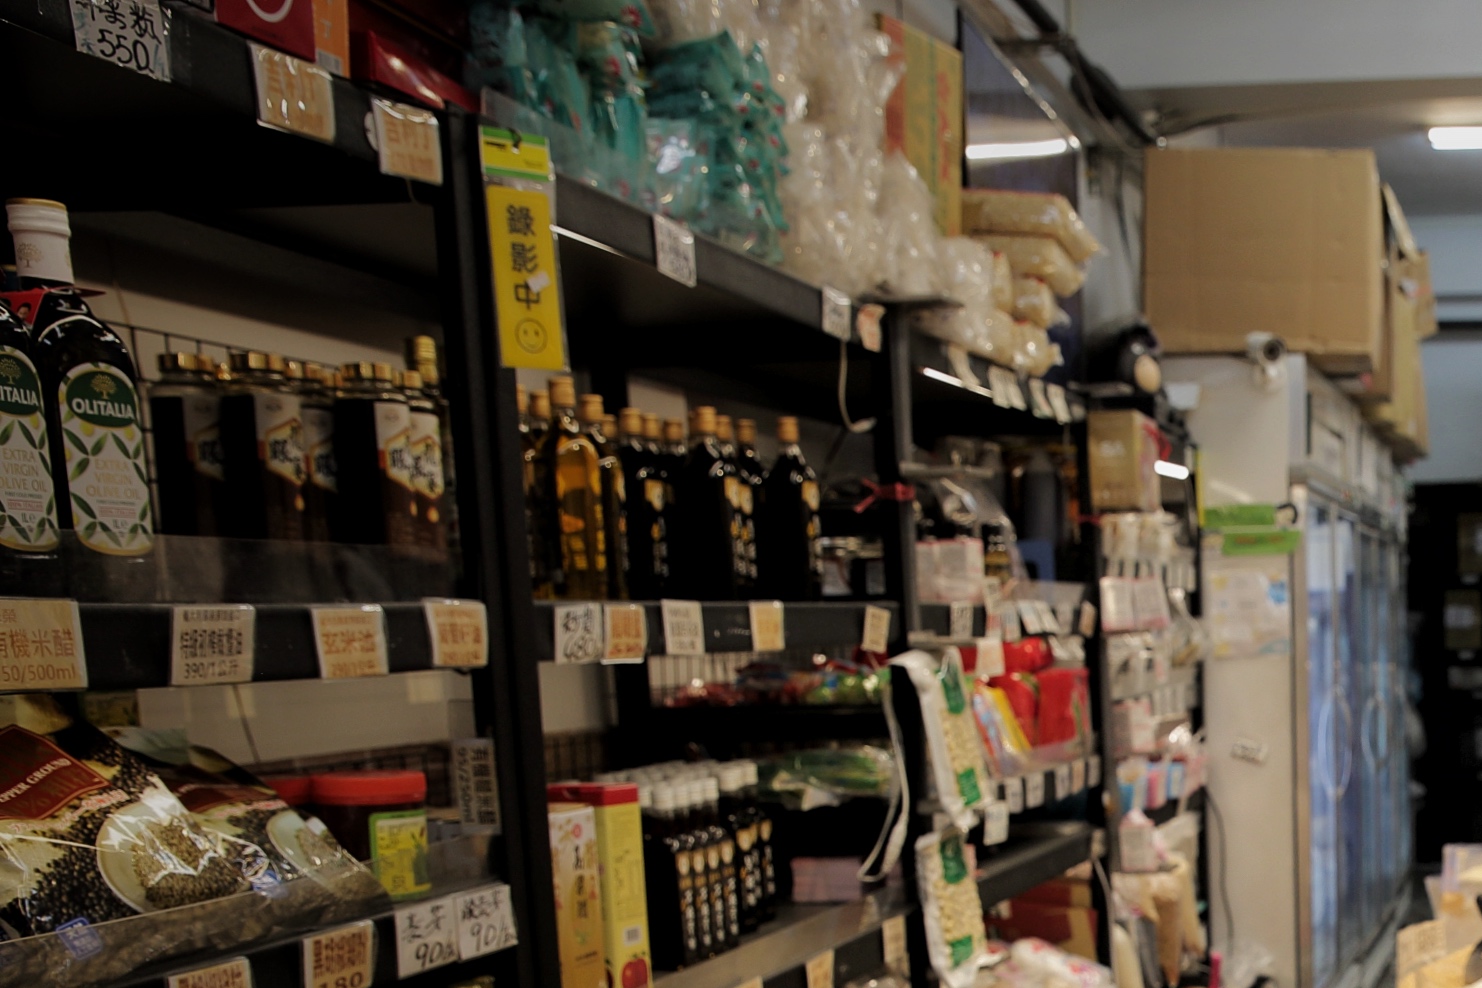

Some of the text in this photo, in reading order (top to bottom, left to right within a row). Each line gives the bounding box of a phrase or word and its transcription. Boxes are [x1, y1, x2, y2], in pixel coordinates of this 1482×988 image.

[97, 28, 155, 73] 550
[506, 204, 541, 311] 錄影中
[71, 397, 135, 420] OLITALIA
[2, 447, 36, 462] EXTRA
[2, 462, 39, 478] VIRGIN
[95, 458, 129, 472] EXTRA
[31, 479, 47, 493] OIL
[85, 484, 141, 501] OLIVE OIL
